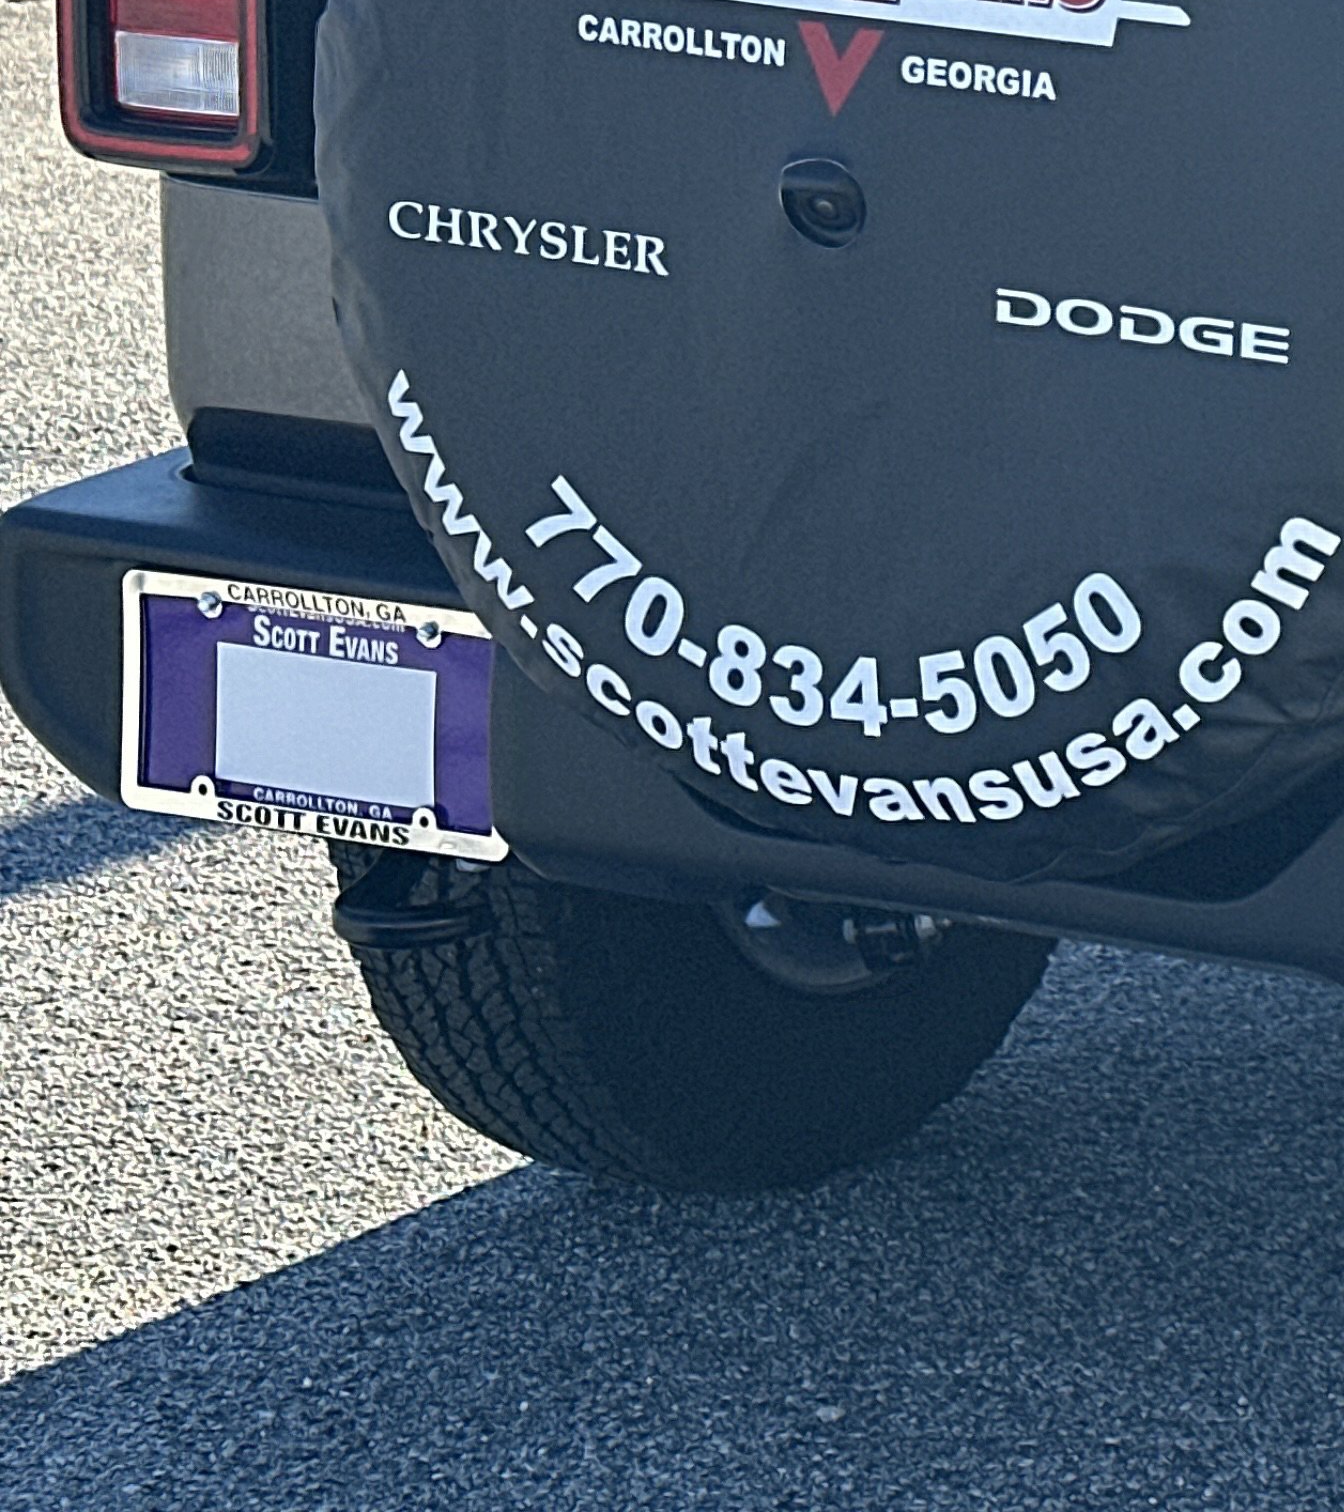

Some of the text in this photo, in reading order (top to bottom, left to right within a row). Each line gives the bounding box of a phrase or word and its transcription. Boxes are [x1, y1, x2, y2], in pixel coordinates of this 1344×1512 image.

[578, 14, 786, 67] CARROLLTON
[901, 55, 1057, 101] GEORGIA
[388, 201, 669, 276] CHRYSLER
[995, 287, 1290, 364] DODGE
[376, 603, 407, 624] GA
[387, 368, 1343, 824] www.scottevansusa.com
[524, 474, 1143, 738] 770-834-5050
[253, 614, 320, 655] SCOTT
[329, 626, 399, 665] EVANS
[217, 800, 411, 846] SCOTT EVANS
[369, 804, 393, 821] GA
